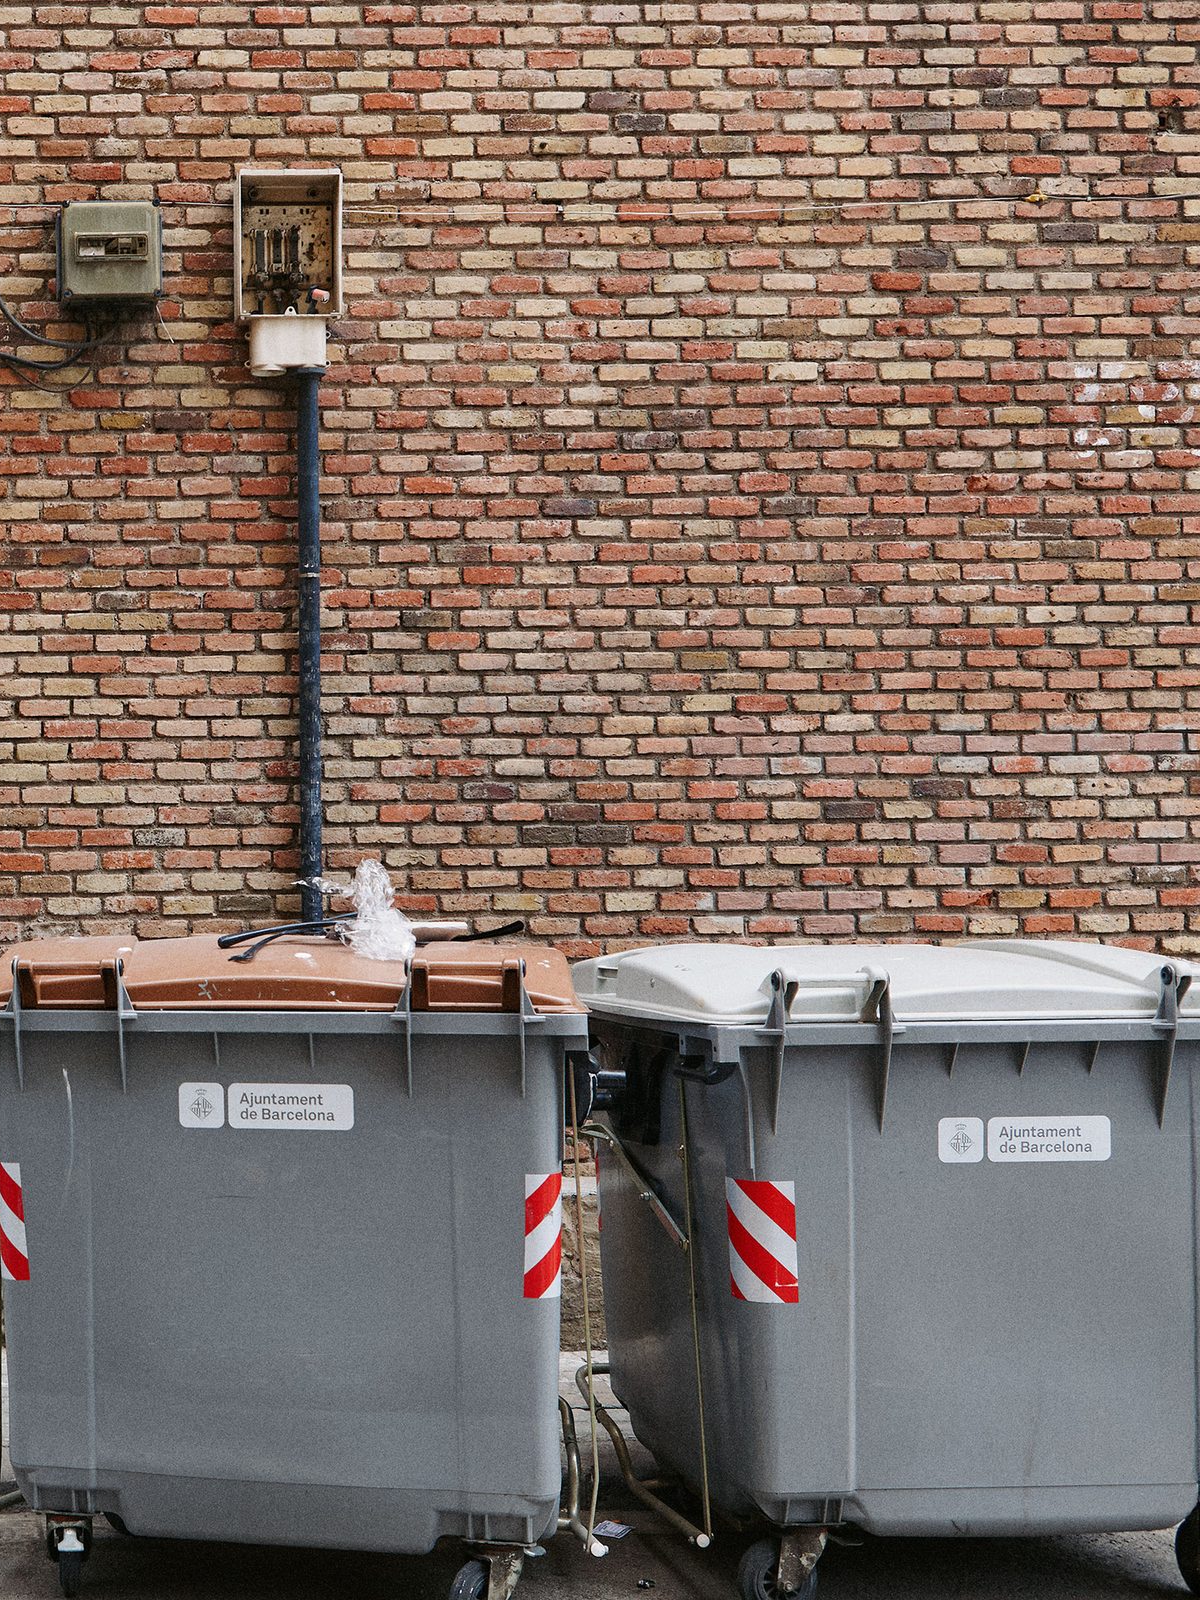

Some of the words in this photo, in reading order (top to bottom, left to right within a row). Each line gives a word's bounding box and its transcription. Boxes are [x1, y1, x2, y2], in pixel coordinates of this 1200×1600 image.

[239, 1092, 324, 1107] Ajuntament
[240, 1108, 258, 1120] de
[261, 1108, 335, 1121] Barcelona
[999, 1126, 1082, 1140] Ajuntament
[999, 1141, 1017, 1153] de
[1020, 1141, 1093, 1153] Barcelona
